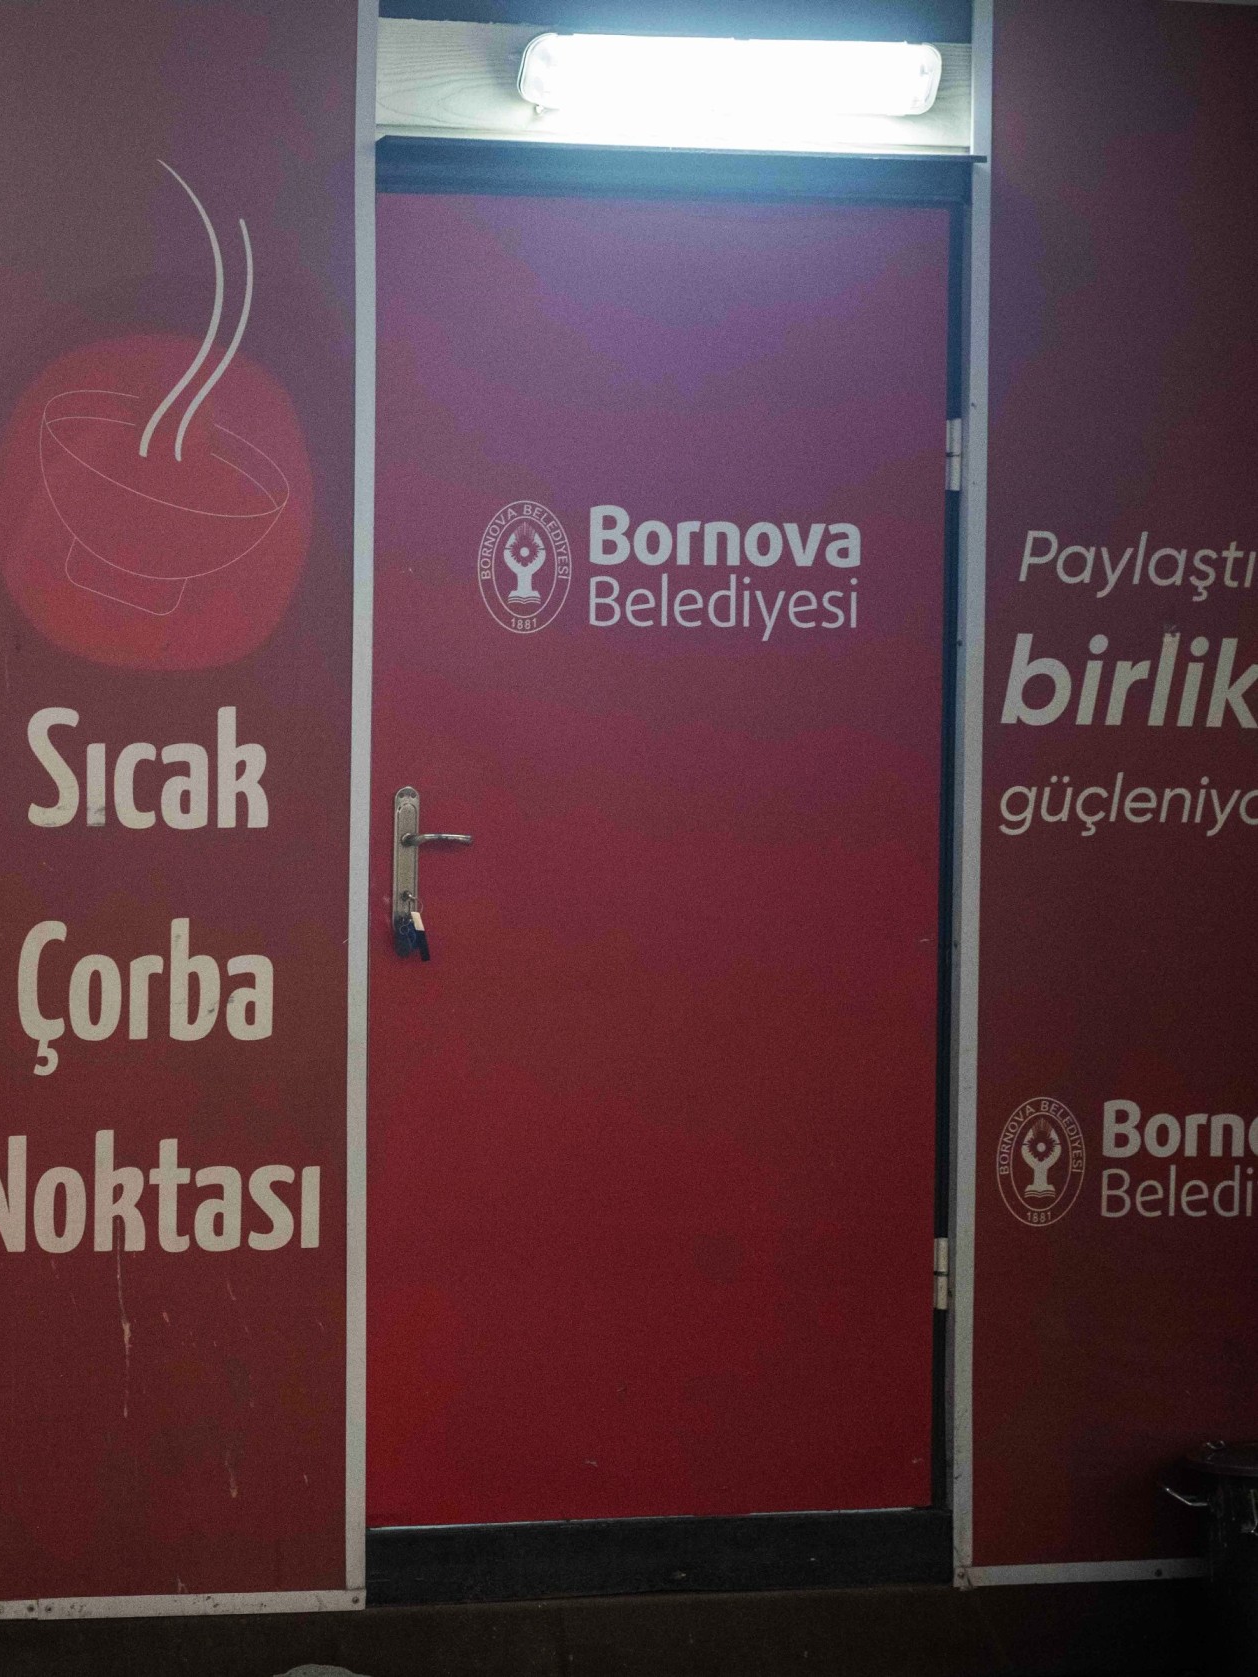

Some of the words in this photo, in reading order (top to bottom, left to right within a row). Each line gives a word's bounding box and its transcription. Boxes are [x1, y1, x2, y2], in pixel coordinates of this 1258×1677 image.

[481, 508, 518, 580] BORNOVA
[589, 505, 861, 567] Bornova
[1019, 530, 1256, 601] Paylaştı
[511, 617, 538, 630] 1881
[589, 573, 858, 641] Belediyesi
[1000, 633, 1258, 729] birlik
[27, 706, 269, 830] Sıcak
[17, 917, 273, 1075] Çorba
[999, 1105, 1036, 1175] BORNOVA
[1102, 1099, 1258, 1158] Born
[1027, 1212, 1052, 1223] 1881
